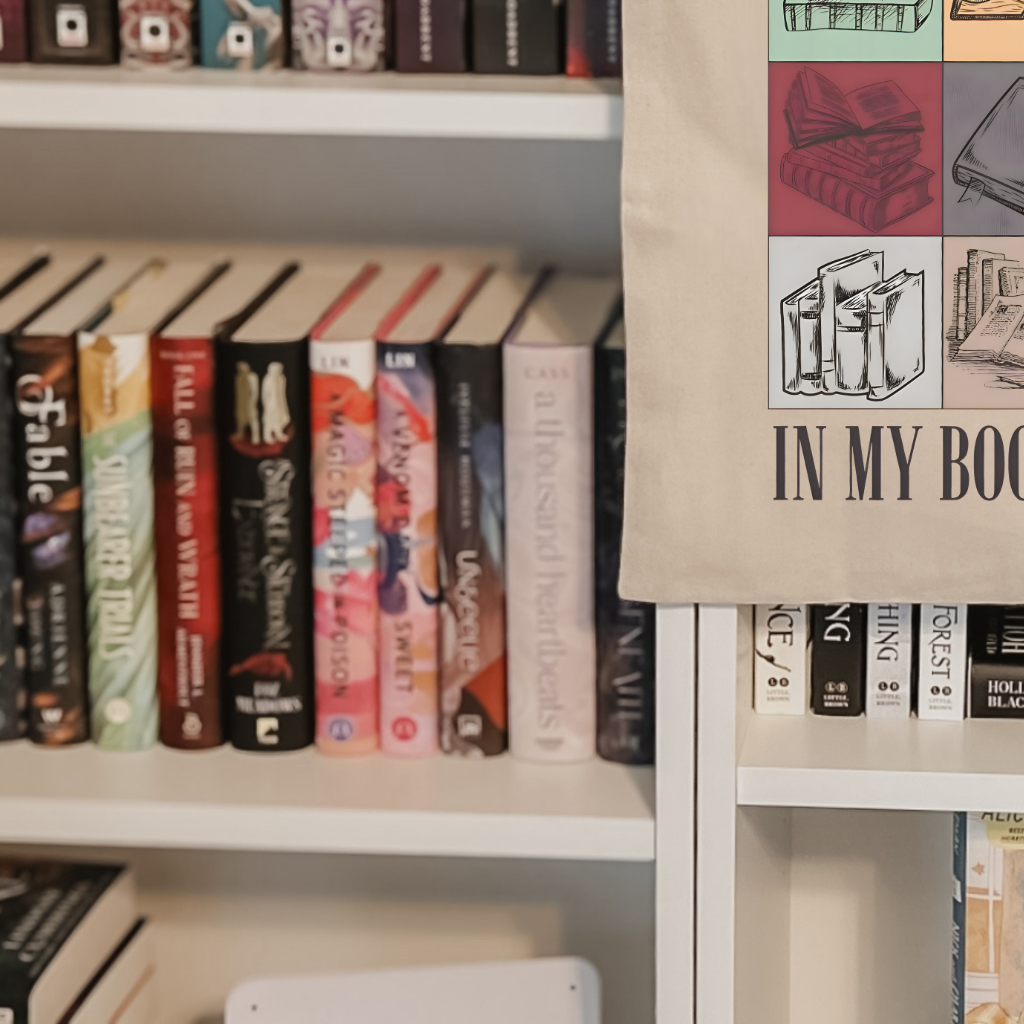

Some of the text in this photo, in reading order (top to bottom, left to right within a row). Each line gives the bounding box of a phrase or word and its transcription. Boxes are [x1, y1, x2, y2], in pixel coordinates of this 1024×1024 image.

[172, 364, 196, 416] FALL
[321, 356, 349, 368] LIN
[384, 351, 416, 368] LIN
[16, 373, 69, 504] Fable
[174, 444, 196, 497] RUIN
[772, 425, 825, 502] IN
[846, 425, 923, 502] MY
[176, 538, 199, 619] WRATH
[325, 411, 348, 698] MAGIC STEEPED POISON
[388, 428, 413, 693] VENOM SWEET
[534, 389, 567, 732] a thousand heartbeats
[928, 604, 958, 679] FOREST
